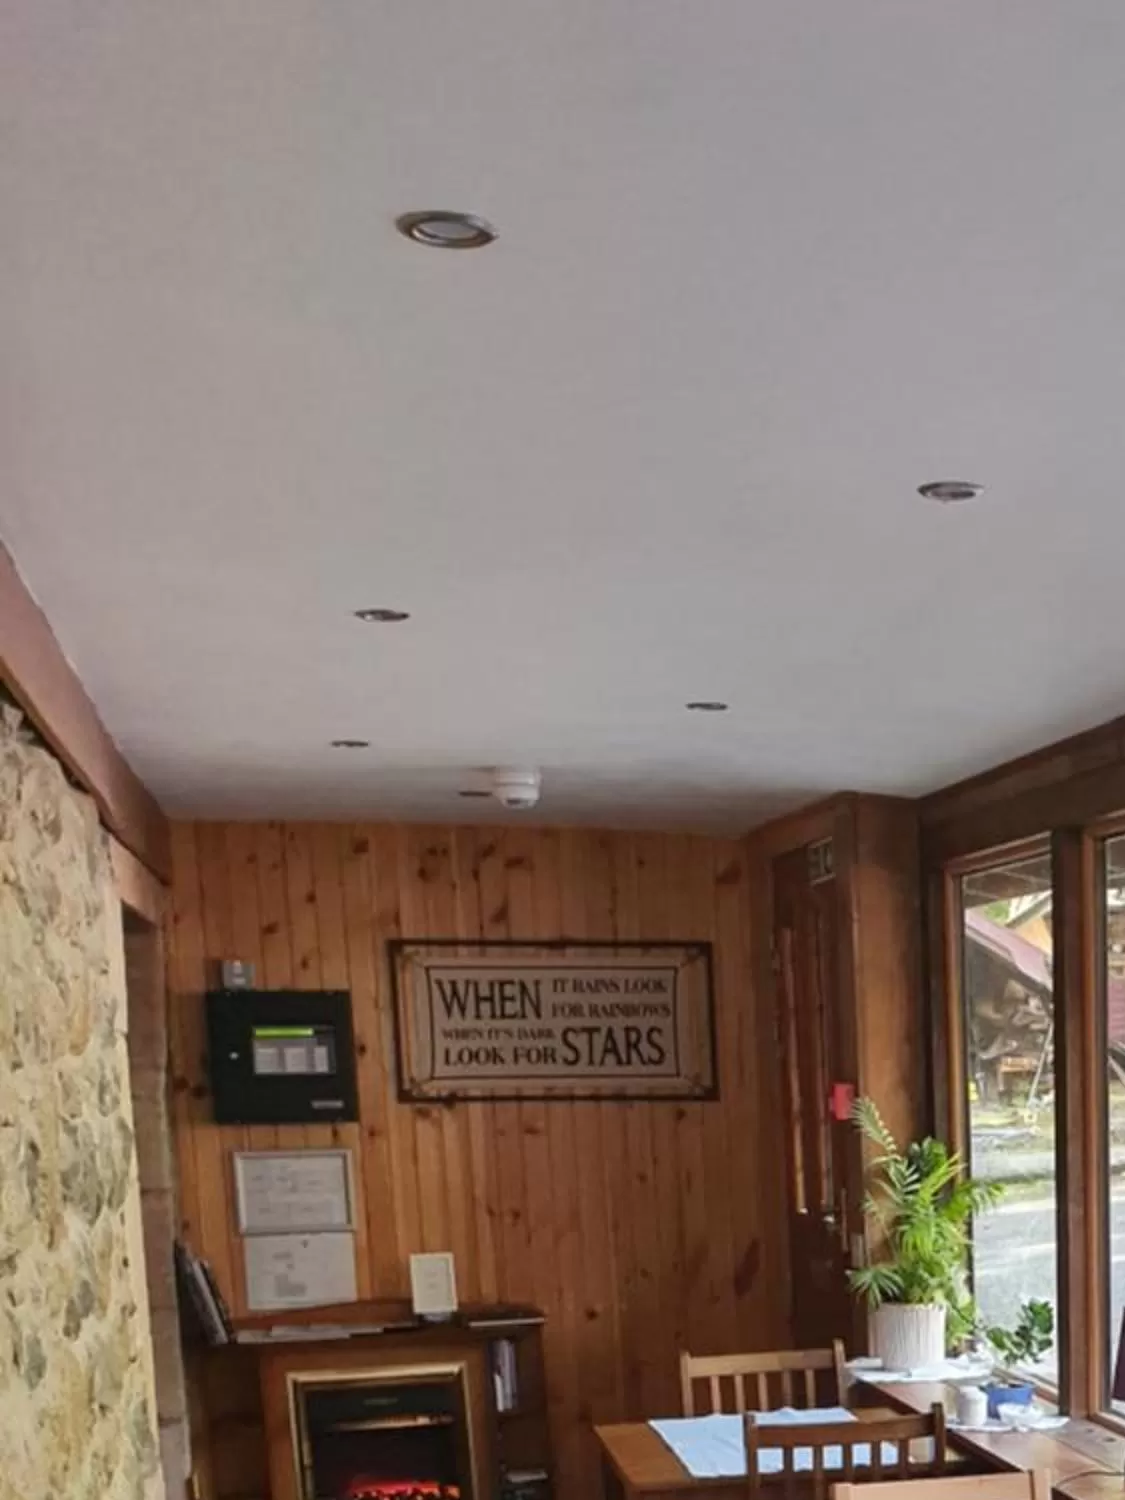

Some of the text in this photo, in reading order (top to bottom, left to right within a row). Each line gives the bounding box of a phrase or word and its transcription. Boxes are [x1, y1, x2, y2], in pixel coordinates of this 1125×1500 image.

[552, 978, 668, 993] IT RAINS LOOK
[433, 978, 542, 1020] WHEN
[551, 1002, 671, 1018] FOR RAINBOWS
[443, 1045, 557, 1067] LOOK FOR
[561, 1025, 667, 1067] STARS
